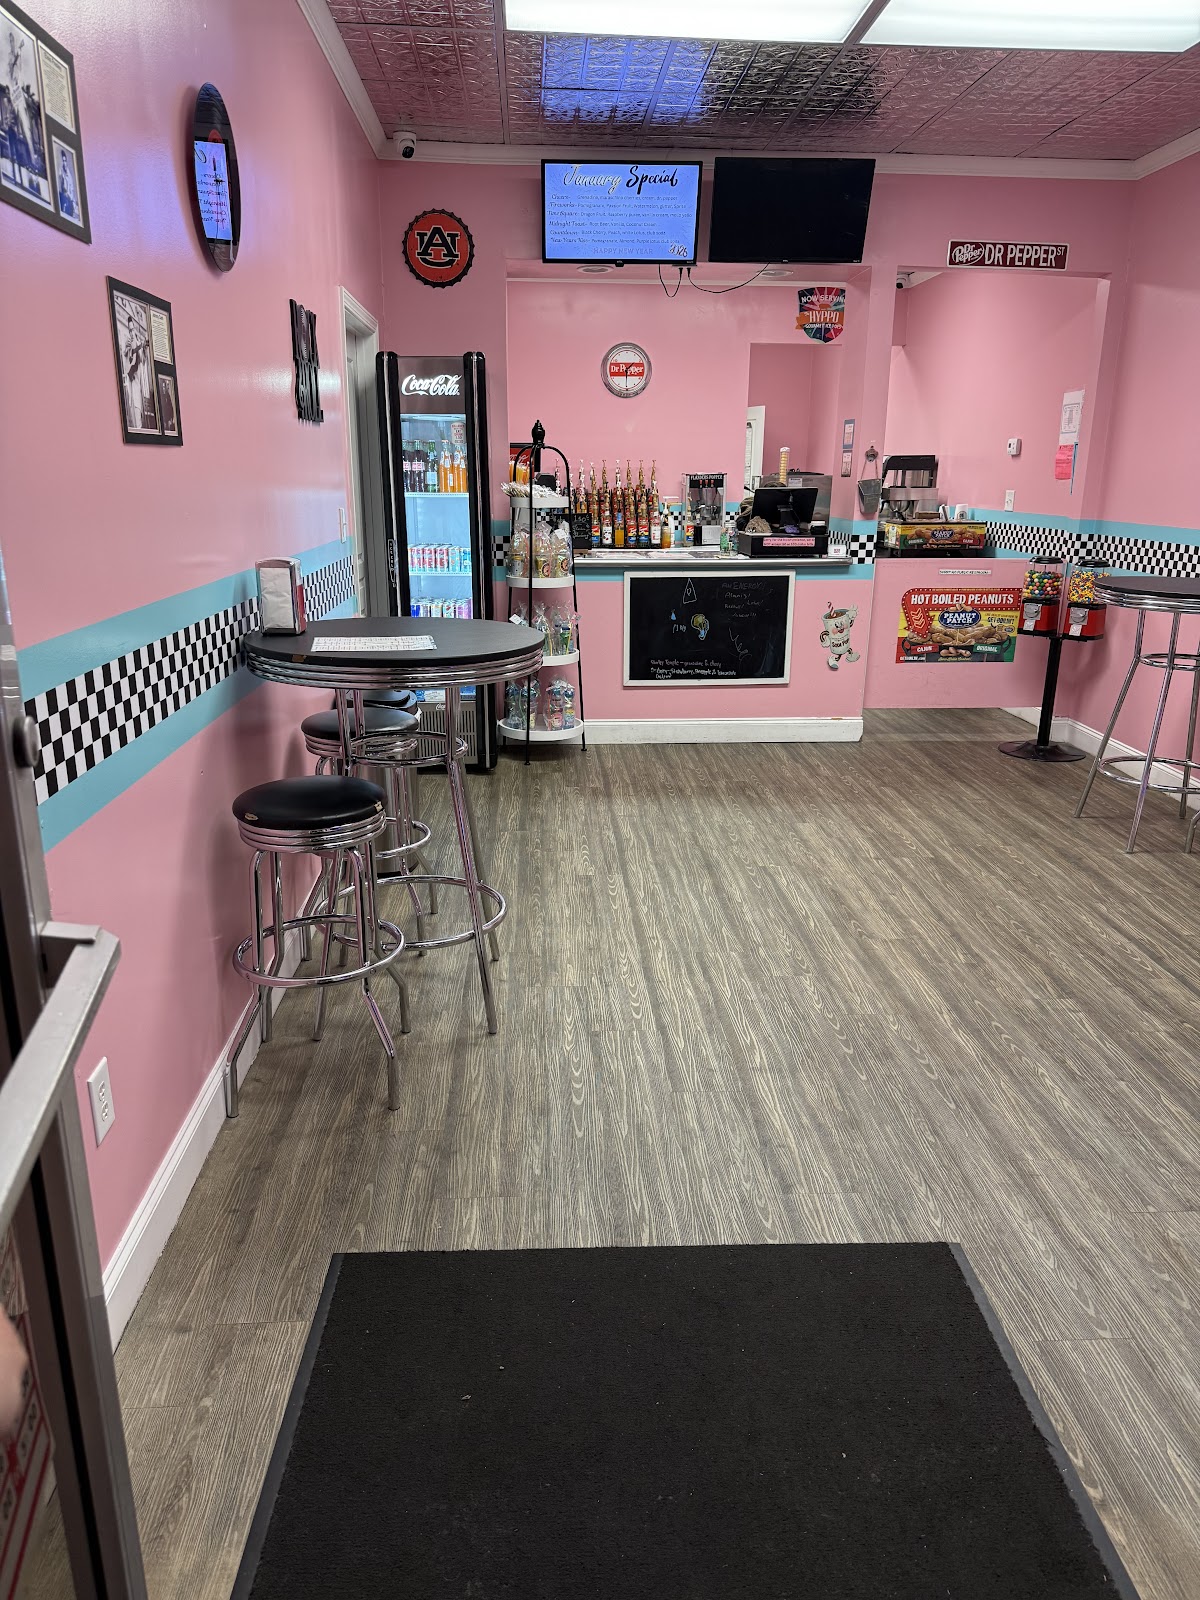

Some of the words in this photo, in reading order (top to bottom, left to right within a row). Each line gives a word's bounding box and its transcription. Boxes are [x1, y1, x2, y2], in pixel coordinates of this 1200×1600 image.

[563, 164, 622, 195] January
[626, 165, 678, 195] Special
[593, 247, 617, 255] HAPPY
[618, 247, 634, 255] NEW
[636, 247, 654, 255] YEAR
[964, 243, 976, 253] Dr
[955, 246, 983, 263] Pepper
[984, 244, 1004, 265] DR
[1007, 244, 1057, 267] PEPPER
[1056, 246, 1065, 256] ST
[801, 295, 819, 303] NOW
[809, 310, 840, 323] HYPPO
[911, 593, 931, 605] HOT
[931, 593, 967, 605] BOILED
[967, 593, 1014, 605] PEANUTS
